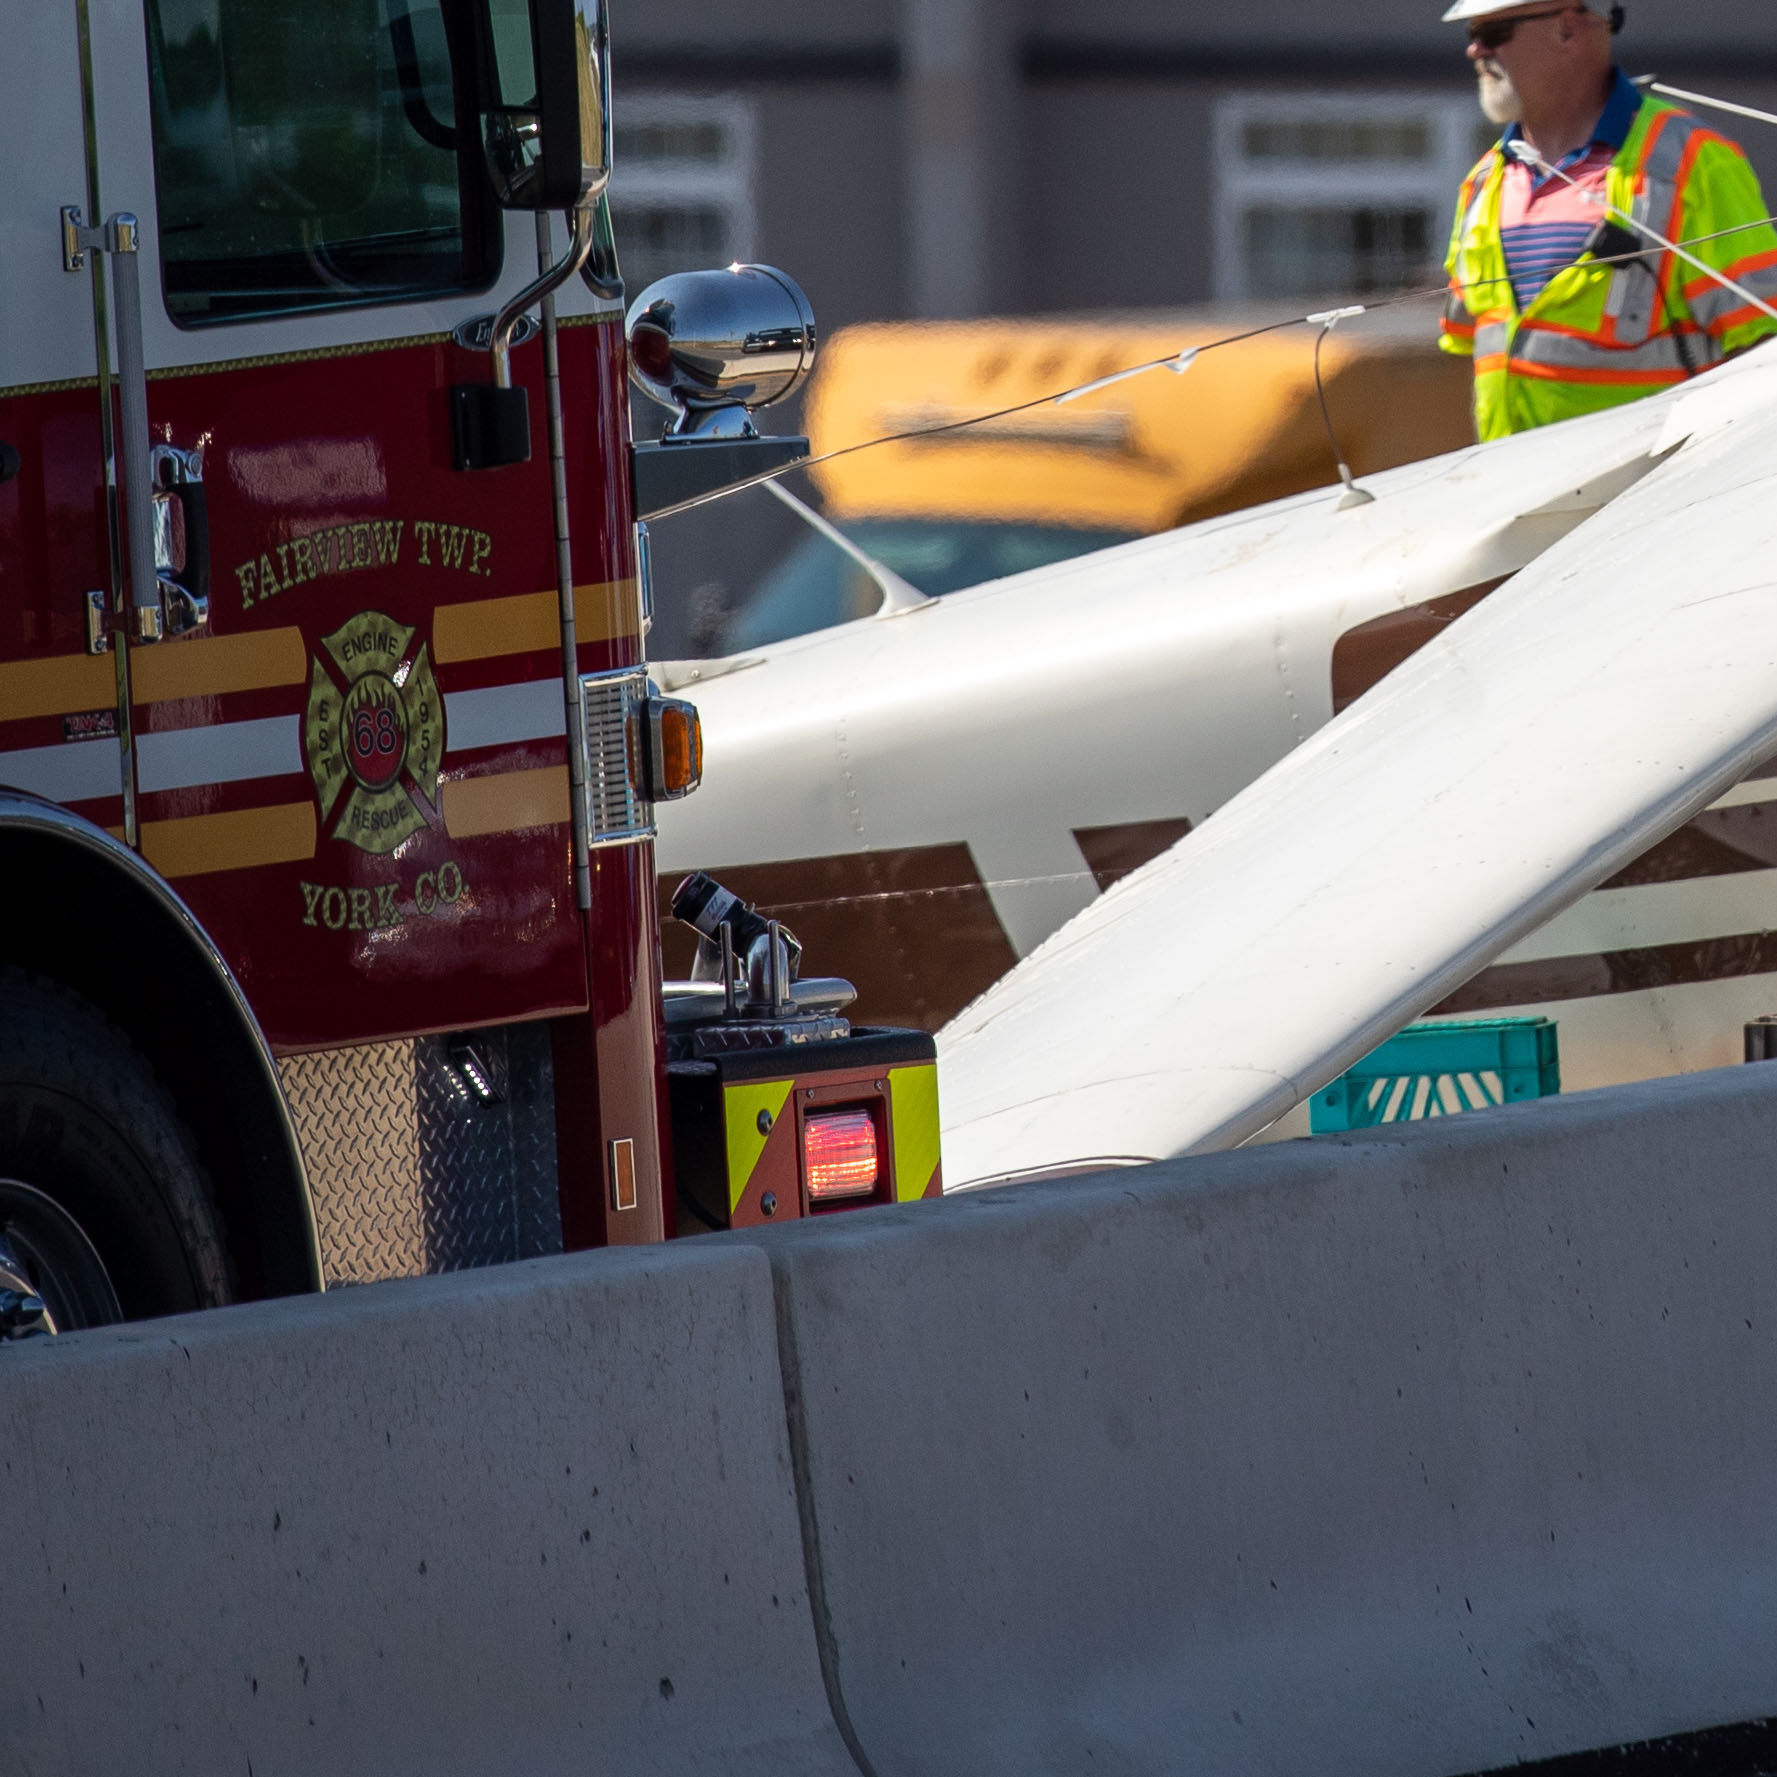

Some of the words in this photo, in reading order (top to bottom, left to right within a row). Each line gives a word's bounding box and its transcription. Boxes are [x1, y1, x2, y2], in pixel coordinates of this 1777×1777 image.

[235, 520, 404, 611] FAIRVIEW
[415, 520, 492, 577] TWP.
[342, 631, 399, 662] ENGINE
[318, 698, 334, 781] EST
[354, 708, 396, 758] 68
[415, 676, 431, 777] 1954
[351, 799, 407, 831] RESCUE
[300, 880, 404, 930] YORK
[415, 860, 470, 915] CO.
